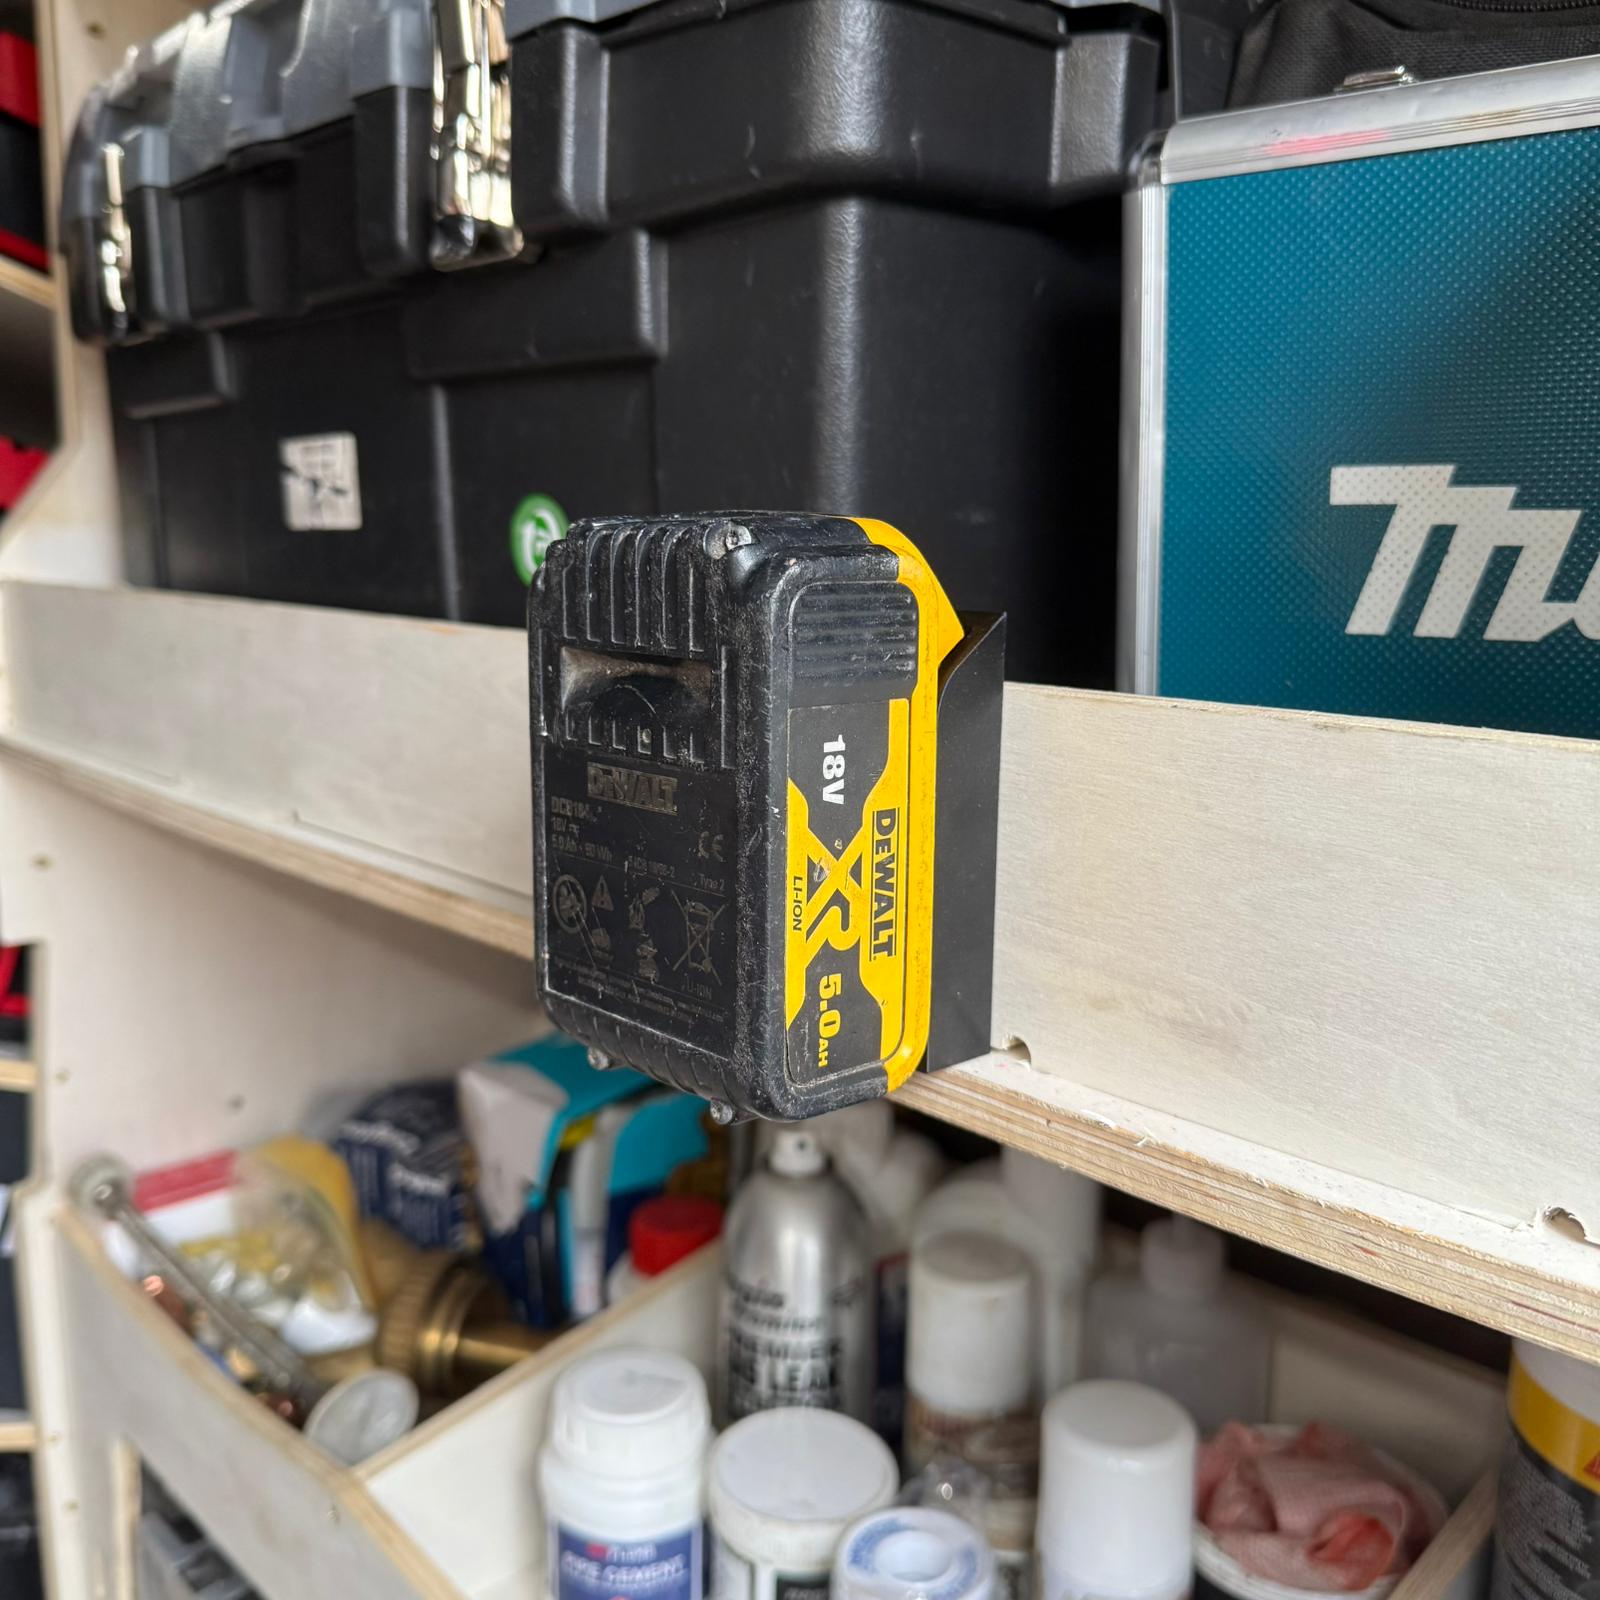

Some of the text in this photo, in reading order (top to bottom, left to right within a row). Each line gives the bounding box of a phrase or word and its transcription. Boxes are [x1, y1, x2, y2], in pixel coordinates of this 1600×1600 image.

[1329, 464, 1600, 642] M
[822, 733, 846, 805] 18V
[793, 875, 804, 932] LI-ION
[805, 827, 863, 968] XR
[873, 807, 897, 959] DEWALT
